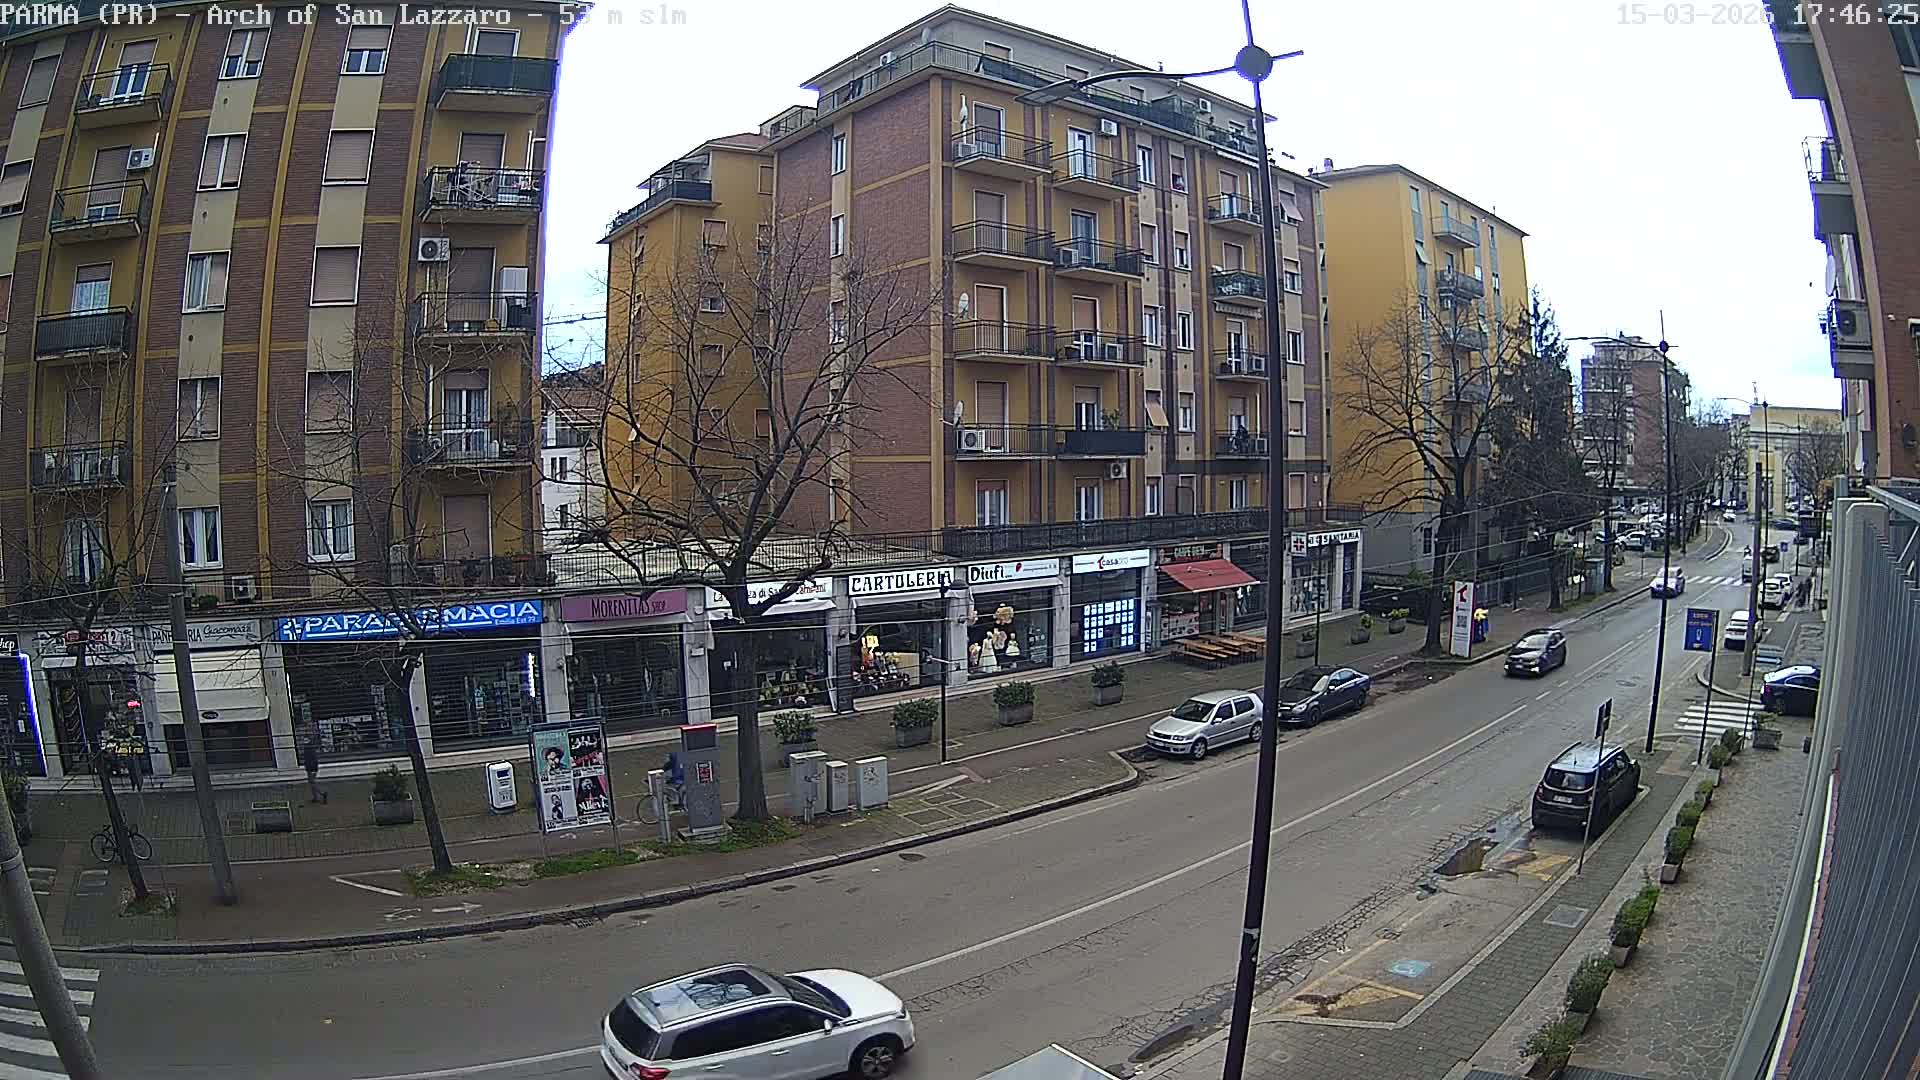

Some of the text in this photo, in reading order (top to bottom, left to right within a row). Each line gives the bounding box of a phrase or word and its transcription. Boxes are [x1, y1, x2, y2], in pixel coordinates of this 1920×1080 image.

[852, 571, 951, 592] CARTOLERIA
[305, 603, 539, 632] PARAFMACIA
[592, 599, 650, 617] MORENITAS
[152, 628, 202, 643] PANRIA
